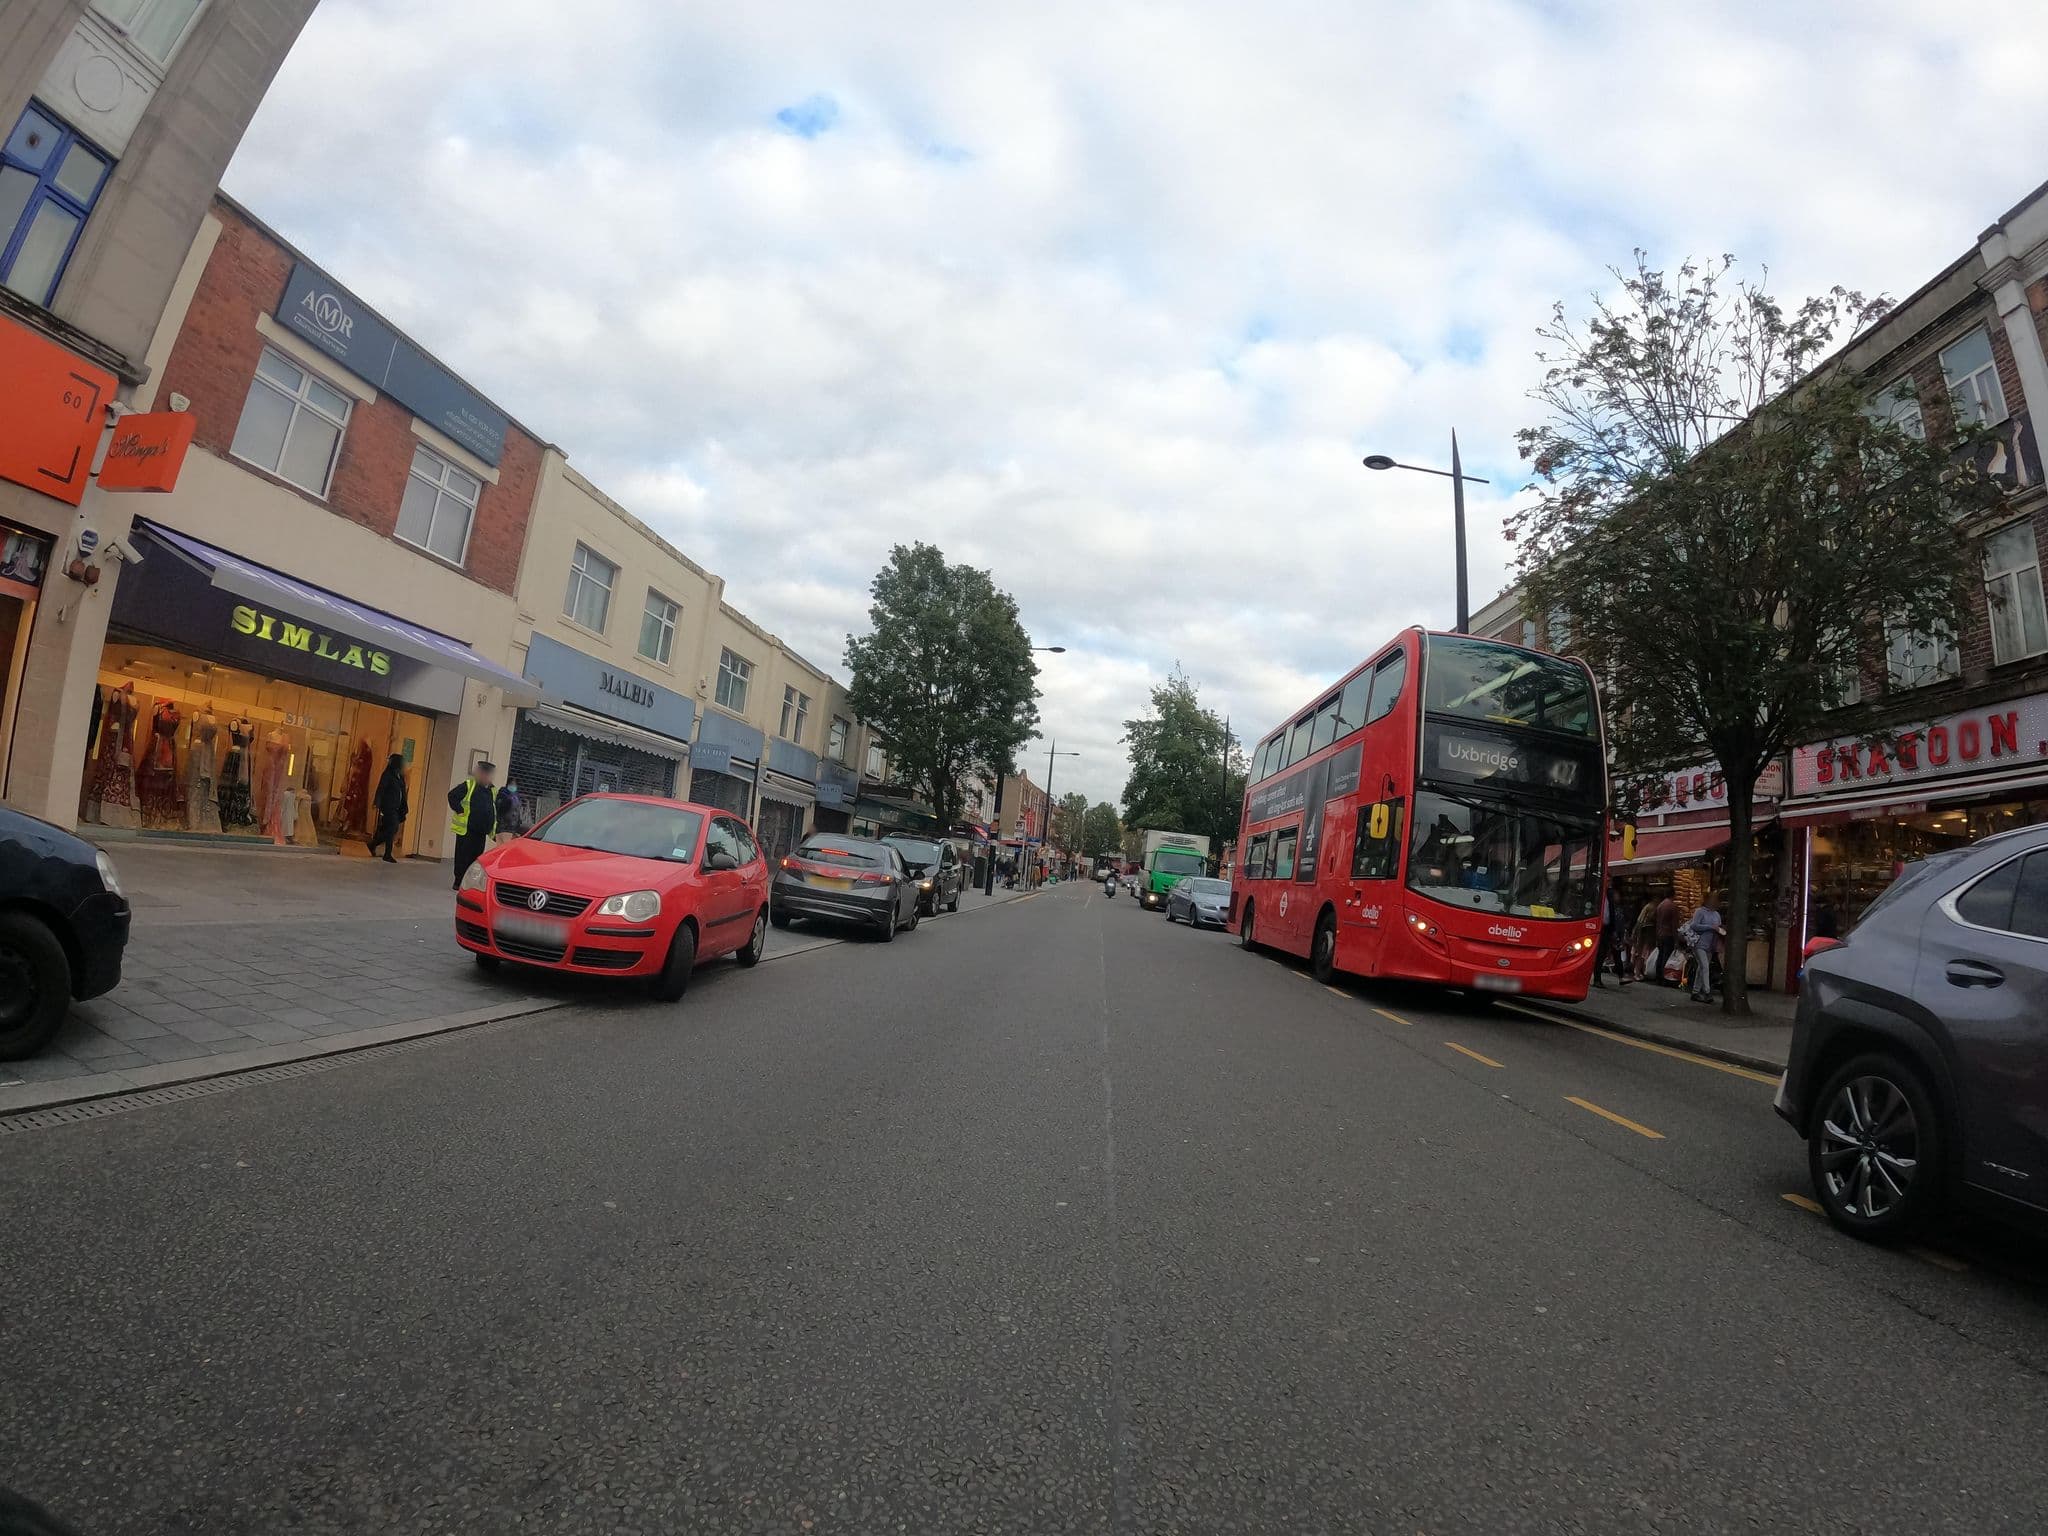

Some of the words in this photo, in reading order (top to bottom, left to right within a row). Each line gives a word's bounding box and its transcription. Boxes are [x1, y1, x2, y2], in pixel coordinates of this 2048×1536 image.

[301, 289, 354, 339] AMR
[63, 391, 82, 409] 60
[230, 604, 391, 676] SIMLA'S
[599, 671, 655, 708] MALHIS
[1447, 742, 1519, 771] Uxbridge
[1488, 923, 1522, 938] abellio
